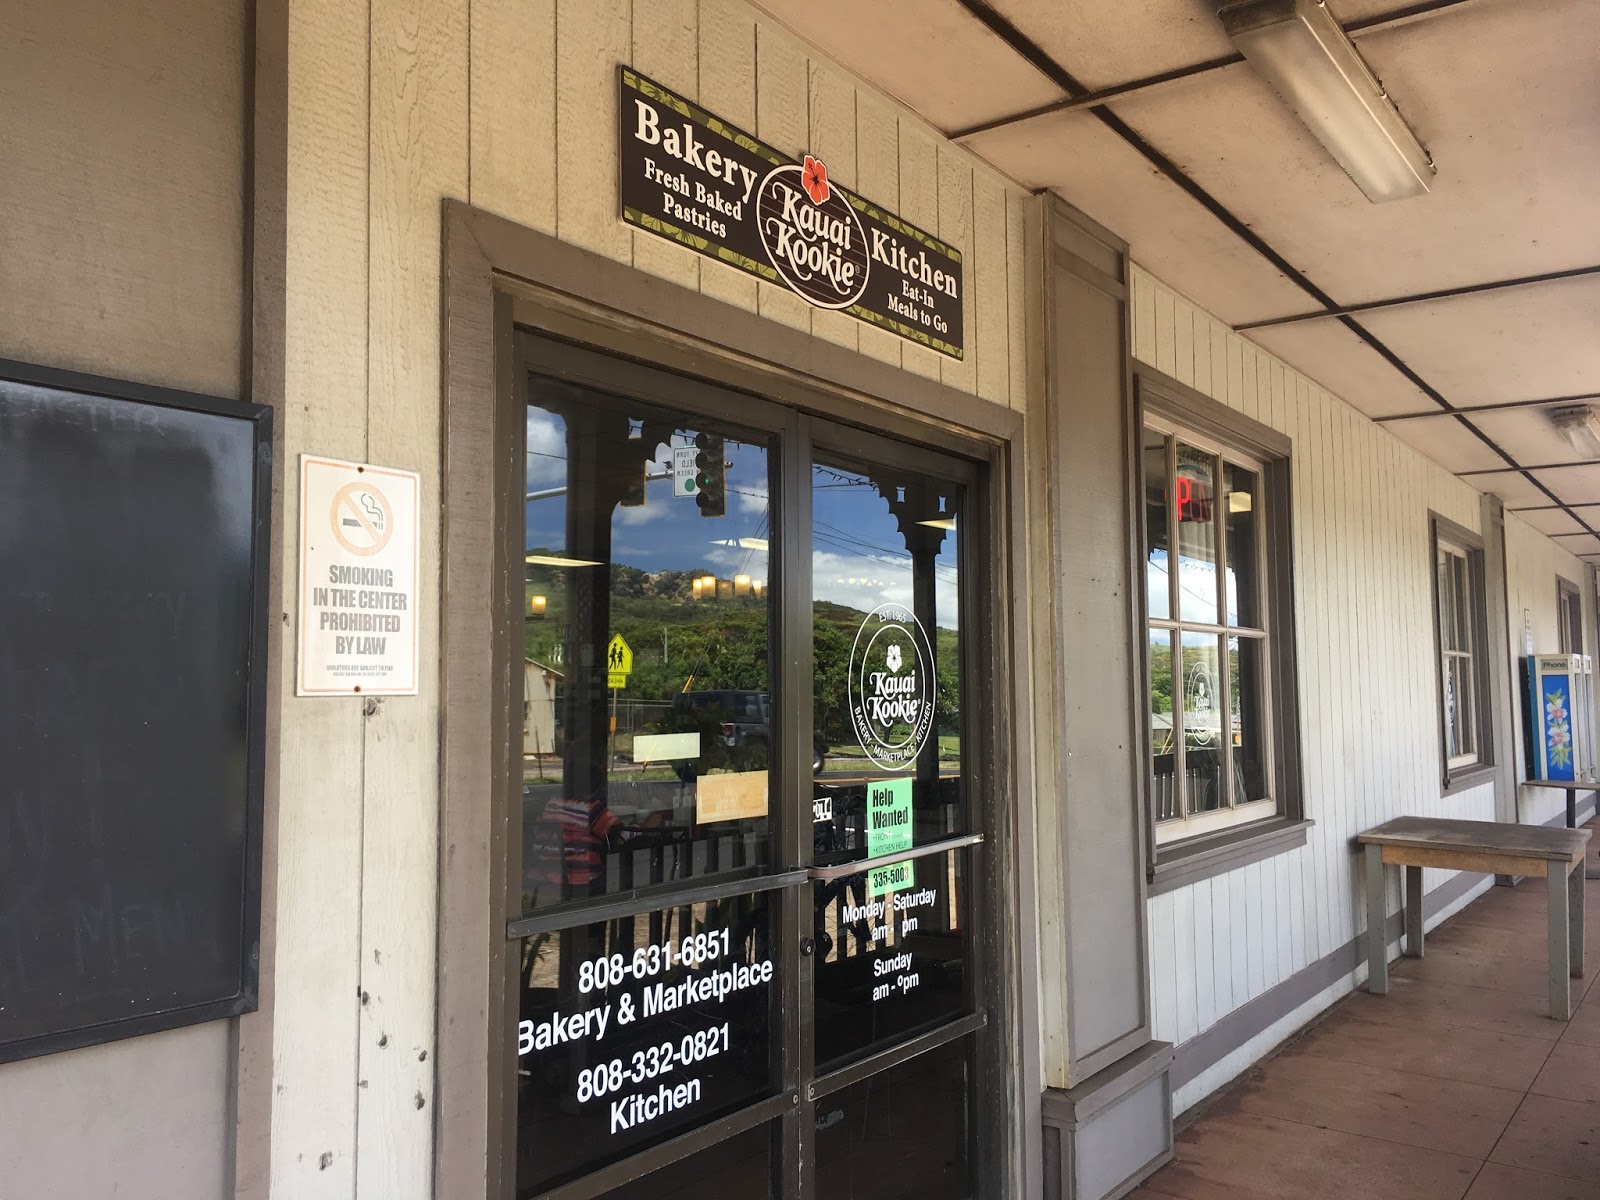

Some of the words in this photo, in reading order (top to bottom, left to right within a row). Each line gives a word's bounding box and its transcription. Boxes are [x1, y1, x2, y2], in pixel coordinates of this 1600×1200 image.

[633, 98, 758, 204] Bakery
[644, 157, 691, 198] Fresh
[694, 181, 743, 221] Baked
[662, 192, 727, 239] Pastries
[772, 181, 851, 250] Kauai
[766, 217, 854, 296] Kookie
[870, 227, 958, 299] Kitchen
[901, 279, 934, 309] Eat-In
[887, 293, 918, 323] Meals
[920, 308, 931, 327] to
[933, 312, 948, 334] Go
[329, 564, 393, 587] SMOKING
[313, 587, 328, 606] IN
[330, 588, 356, 608] THE
[358, 590, 407, 610] CENTER
[320, 611, 401, 633] PROHIBITED
[892, 610, 907, 624] 1965
[335, 635, 354, 655] BY
[356, 636, 386, 655] LAW
[1542, 661, 1567, 669] Phone
[869, 669, 916, 700] Kauai
[866, 692, 918, 727] Kookie
[854, 706, 872, 745] BAKERY
[873, 742, 915, 763] MARKETPLACE
[915, 701, 932, 744] KITCHEN
[872, 787, 894, 808] Help
[872, 806, 909, 830] Wanted
[875, 843, 895, 854] KITCHEN
[896, 841, 908, 850] HELP
[873, 866, 909, 889] 335-5003
[842, 899, 885, 924] Monday
[893, 887, 937, 913] Saturday
[872, 924, 888, 942] am
[902, 917, 918, 938] pm
[578, 927, 730, 994] 808-631-6851
[873, 952, 912, 977] Sunday
[518, 1003, 611, 1056] Bakery
[617, 992, 636, 1026] &
[642, 958, 774, 1018] Marketplace
[873, 983, 889, 1001] am
[576, 1021, 730, 1104] 808-332-0821
[609, 1077, 701, 1136] Kitchen
